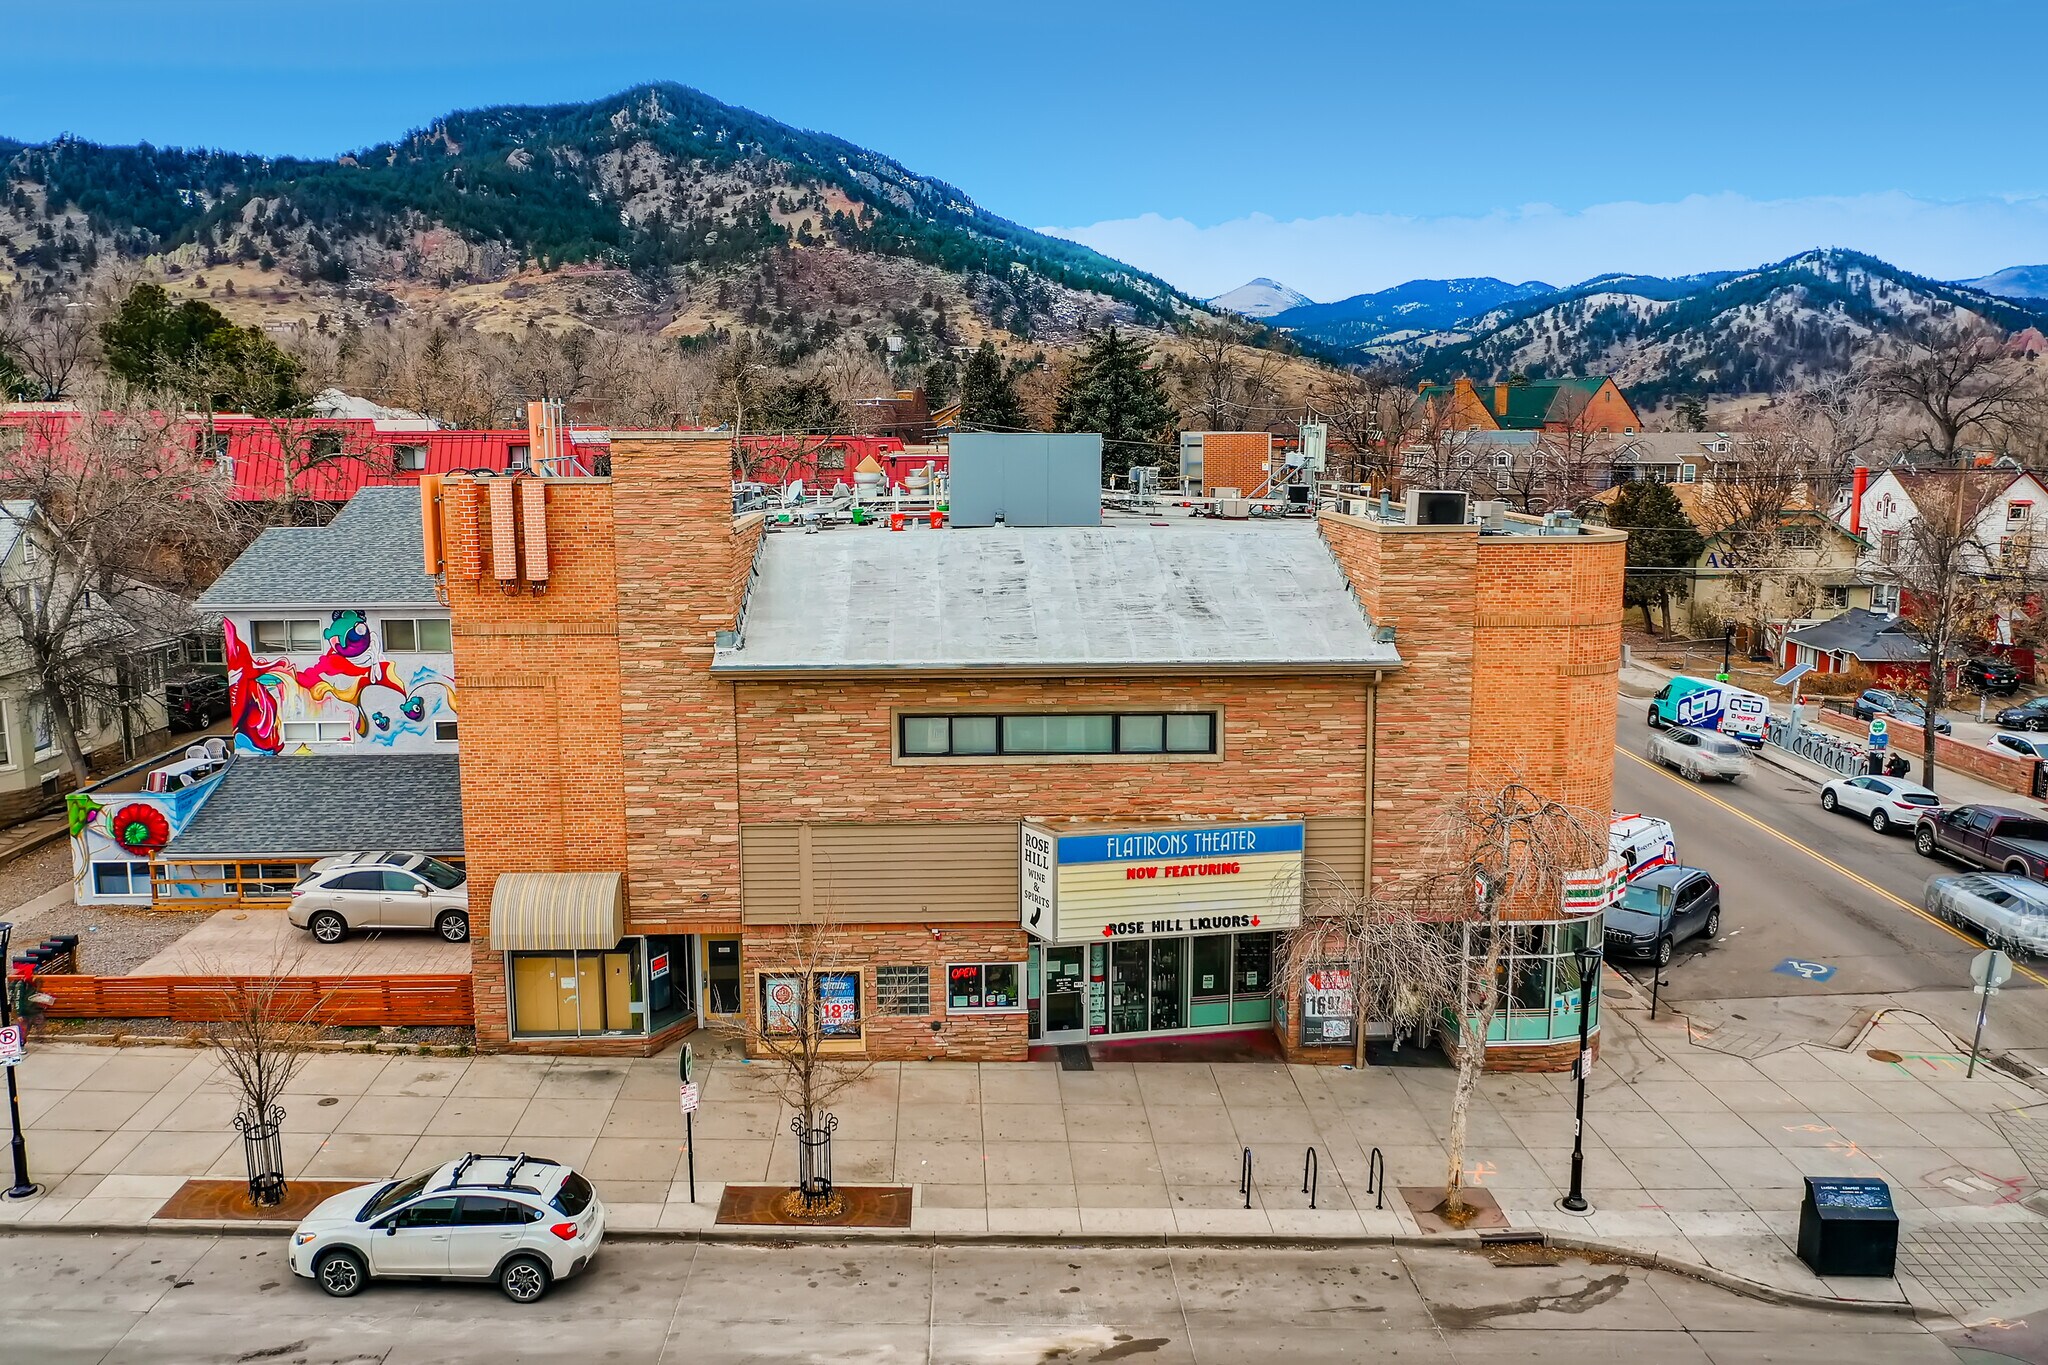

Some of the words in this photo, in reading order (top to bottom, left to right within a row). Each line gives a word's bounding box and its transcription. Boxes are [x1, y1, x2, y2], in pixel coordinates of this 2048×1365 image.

[1729, 698, 1763, 714] QED
[1736, 714, 1757, 722] legrand
[1025, 833, 1050, 855] ROSE
[1107, 833, 1188, 858] FLATIRONS
[1193, 830, 1256, 853] THEATER
[1024, 848, 1050, 870] HILL
[1027, 868, 1046, 884] WINE
[1126, 866, 1158, 880] NOW
[1164, 862, 1241, 878] FEATURING
[1033, 881, 1040, 893] &
[1024, 889, 1050, 909] SPIRITS
[1108, 921, 1145, 935] ROSE
[1151, 919, 1183, 932] HILL
[1189, 914, 1250, 931] LIQUORS
[951, 967, 977, 980] OPEN
